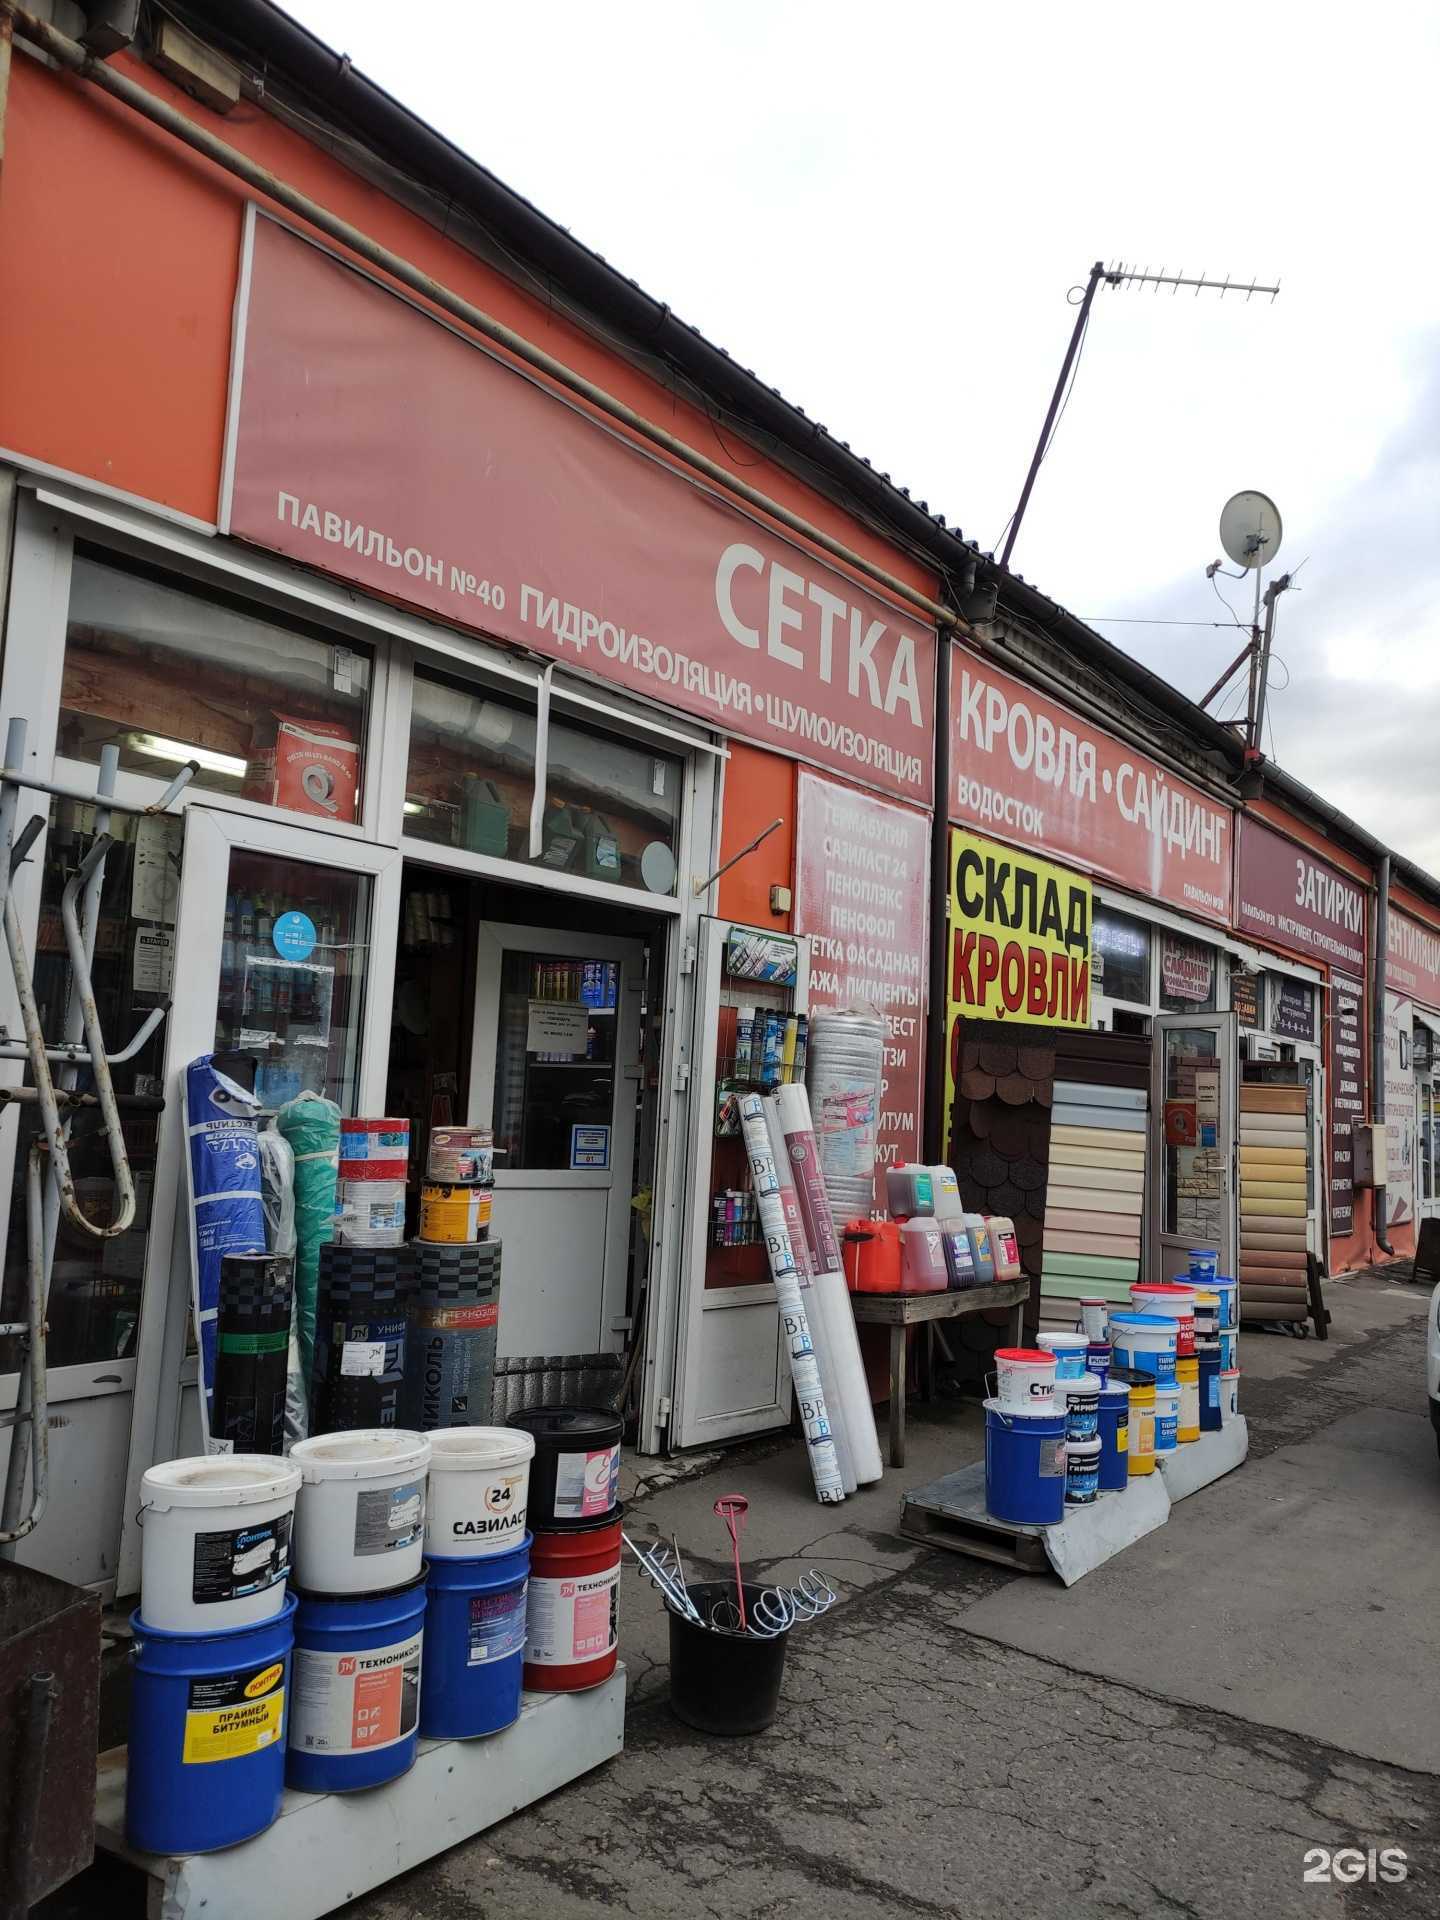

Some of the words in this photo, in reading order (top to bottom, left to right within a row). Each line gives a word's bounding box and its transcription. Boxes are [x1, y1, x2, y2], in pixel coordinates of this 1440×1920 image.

[277, 490, 444, 587] ПАВИЛЬОН
[450, 569, 505, 611] №40
[715, 543, 923, 729] СЕТКА
[519, 584, 752, 714] ГИДРОИЗОЛЯЦИЯ
[767, 702, 922, 786] ШУМОИЗОЛЯЦИЯ
[960, 670, 1097, 802] КРОВЛЯ
[1116, 771, 1227, 865] САЙДИНГ
[957, 775, 1044, 838] ВОДОСТОК
[824, 836, 890, 874] САЗИЛАСТ
[893, 859, 908, 881] 24
[825, 870, 903, 910] ПЕНОПЛЭКС
[956, 849, 1088, 961] СКЛАД
[1295, 859, 1363, 936] ЗАТИРКИ
[830, 906, 895, 939] ПЕНОФОЛ
[846, 944, 920, 977] ФАСАДНАЯ
[1388, 911, 1440, 983] ЕНТИЛЯЦИ
[808, 969, 843, 997] АЖА,
[846, 976, 919, 1006] ПИГМЕНТЫ
[953, 928, 1088, 1025] КРОВЛИ
[876, 1111, 914, 1131] ИТУМ
[875, 1144, 898, 1163] КУТ
[491, 1487, 511, 1503] 24
[453, 1508, 527, 1535] САЗИЛАСТ
[212, 1711, 269, 1735] БИТУМНЫЙ
[219, 1703, 266, 1723] ПРАЙМЕР
